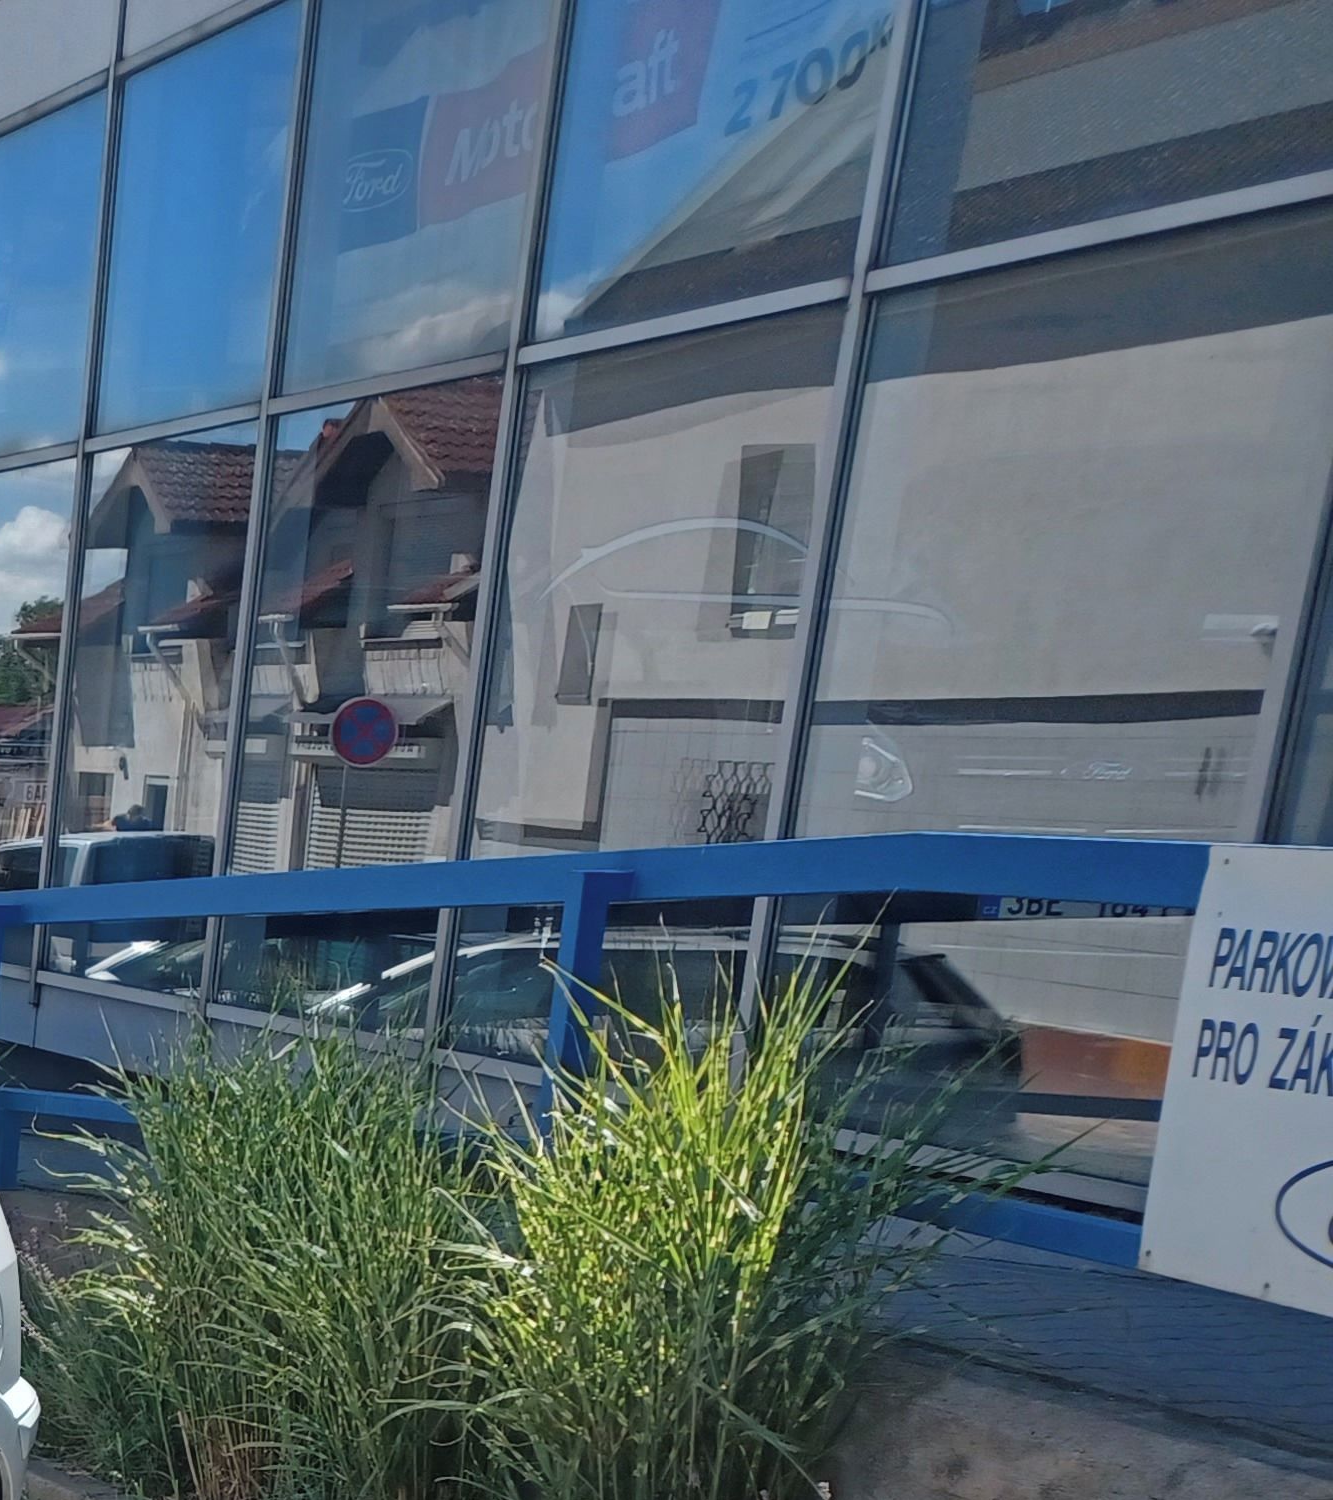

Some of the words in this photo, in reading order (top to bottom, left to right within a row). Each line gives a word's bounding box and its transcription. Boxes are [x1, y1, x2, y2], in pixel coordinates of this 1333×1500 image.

[343, 159, 404, 205] Ford
[1209, 927, 1333, 999] PARKOV
[1192, 1018, 1260, 1085] PRO
[1268, 1013, 1333, 1097] ZÁK
